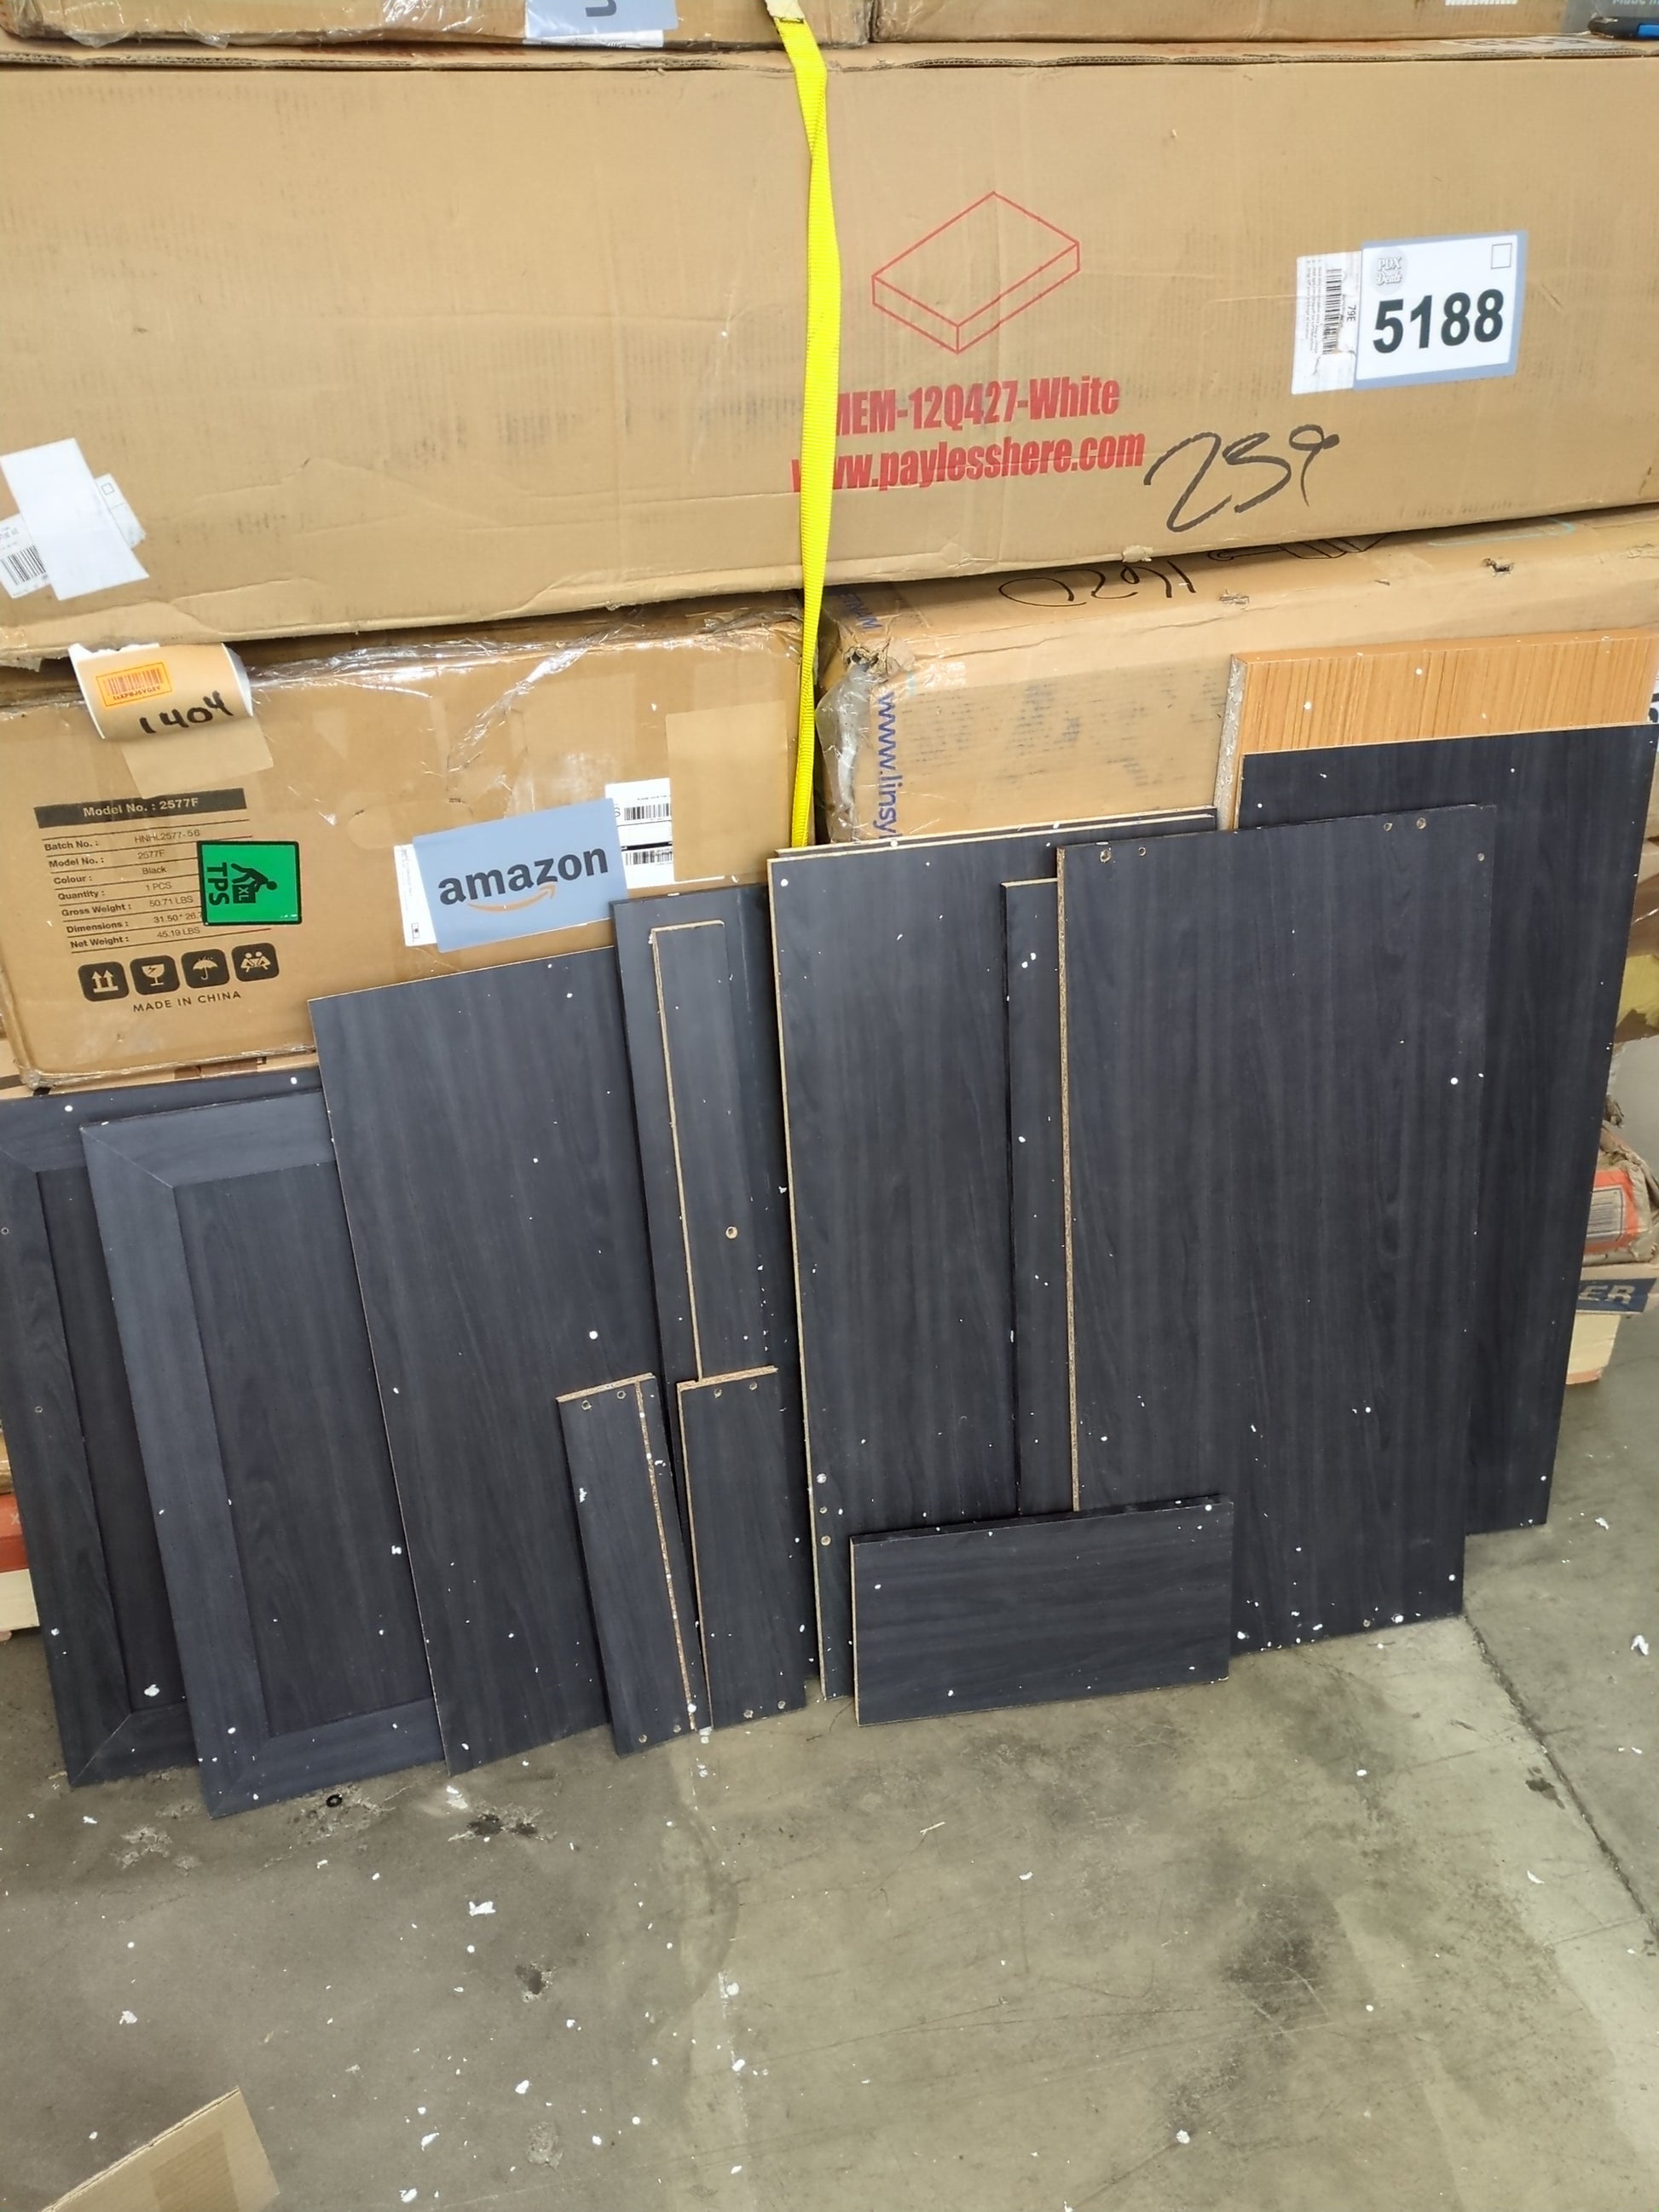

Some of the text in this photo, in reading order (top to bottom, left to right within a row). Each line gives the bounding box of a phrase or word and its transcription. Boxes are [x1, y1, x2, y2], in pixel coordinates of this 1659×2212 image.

[1377, 257, 1402, 271] PDX
[1375, 271, 1402, 286] Deals
[1373, 288, 1504, 354] 5188
[139, 690, 234, 734] 1404
[83, 805, 123, 817] Model
[159, 797, 199, 810] 2577F
[44, 840, 74, 852] Batch
[49, 858, 79, 868] Model
[137, 849, 165, 859] 2577F
[54, 875, 86, 885] Colour
[142, 865, 167, 875] Black
[206, 862, 230, 906] TPS
[437, 847, 609, 905] amazon
[57, 890, 99, 900] Quantity
[152, 881, 172, 891] PCS
[238, 887, 250, 901] XL
[91, 904, 126, 914] Weight
[149, 898, 173, 907] 50.71
[175, 895, 194, 904] LBS
[66, 921, 123, 933] Dimensions
[70, 939, 88, 949] Net
[90, 936, 124, 946] Weight
[157, 929, 181, 938] 45.19
[182, 927, 201, 935] LBS
[133, 990, 241, 1013] MADE IN CHINA
